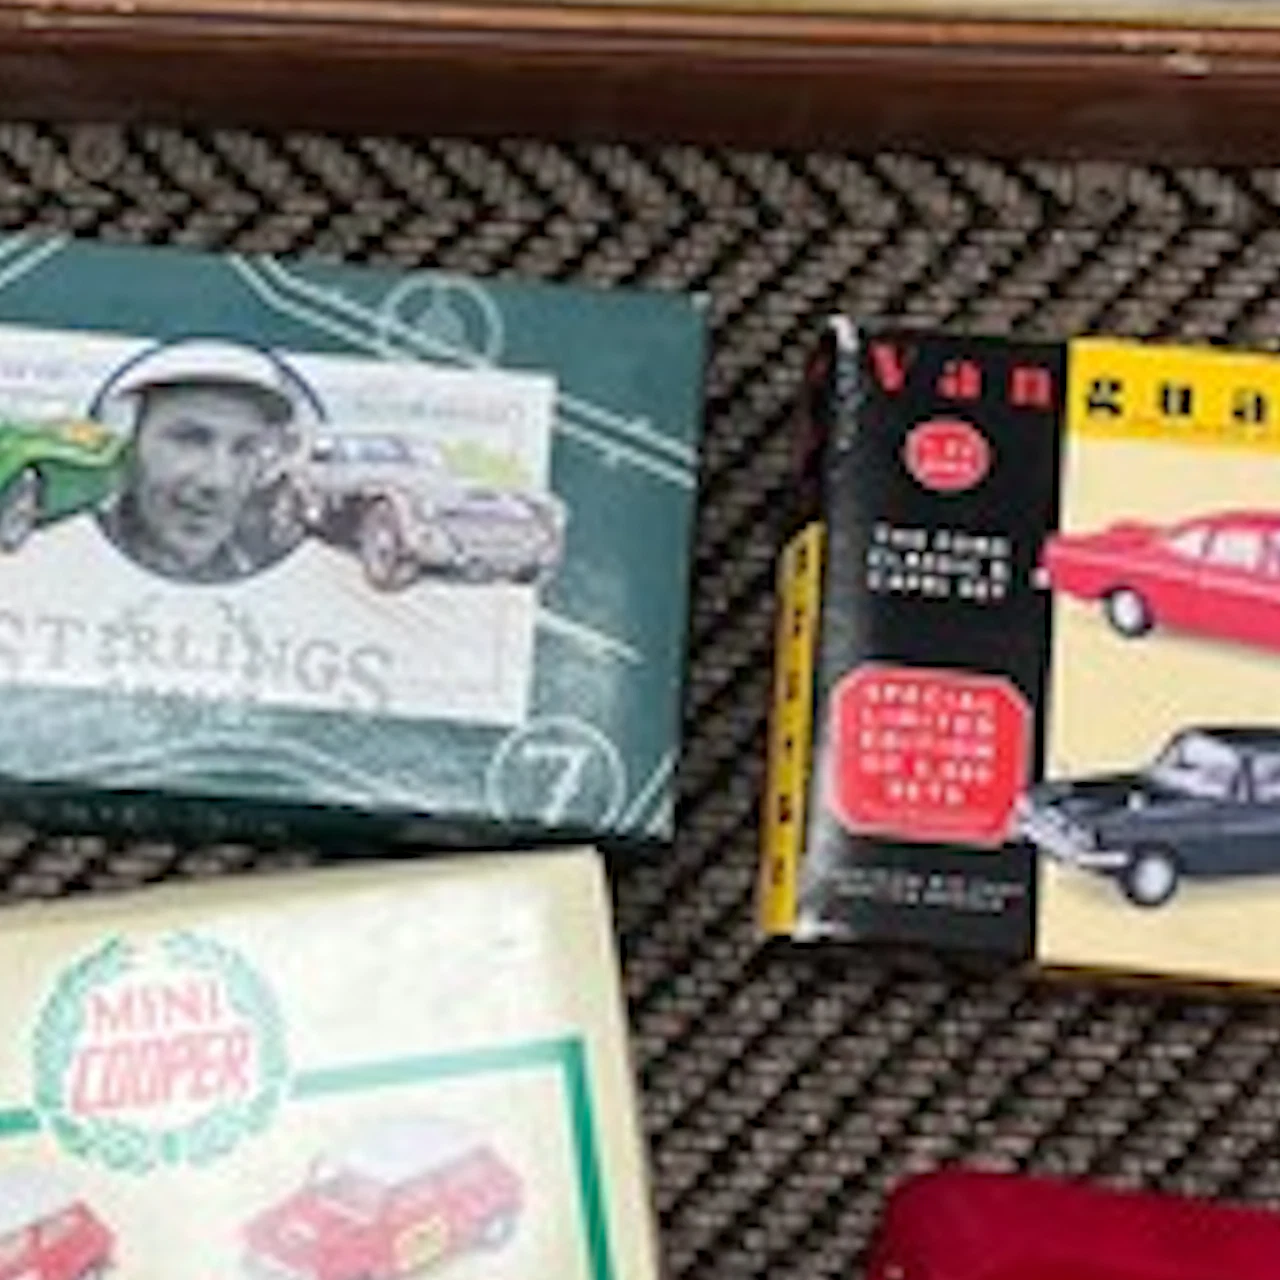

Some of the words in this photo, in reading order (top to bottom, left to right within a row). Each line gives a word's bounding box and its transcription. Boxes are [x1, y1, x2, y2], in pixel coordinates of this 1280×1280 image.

[523, 742, 591, 826] 7
[87, 978, 220, 1036] MINI
[72, 1026, 251, 1115] COOPER
